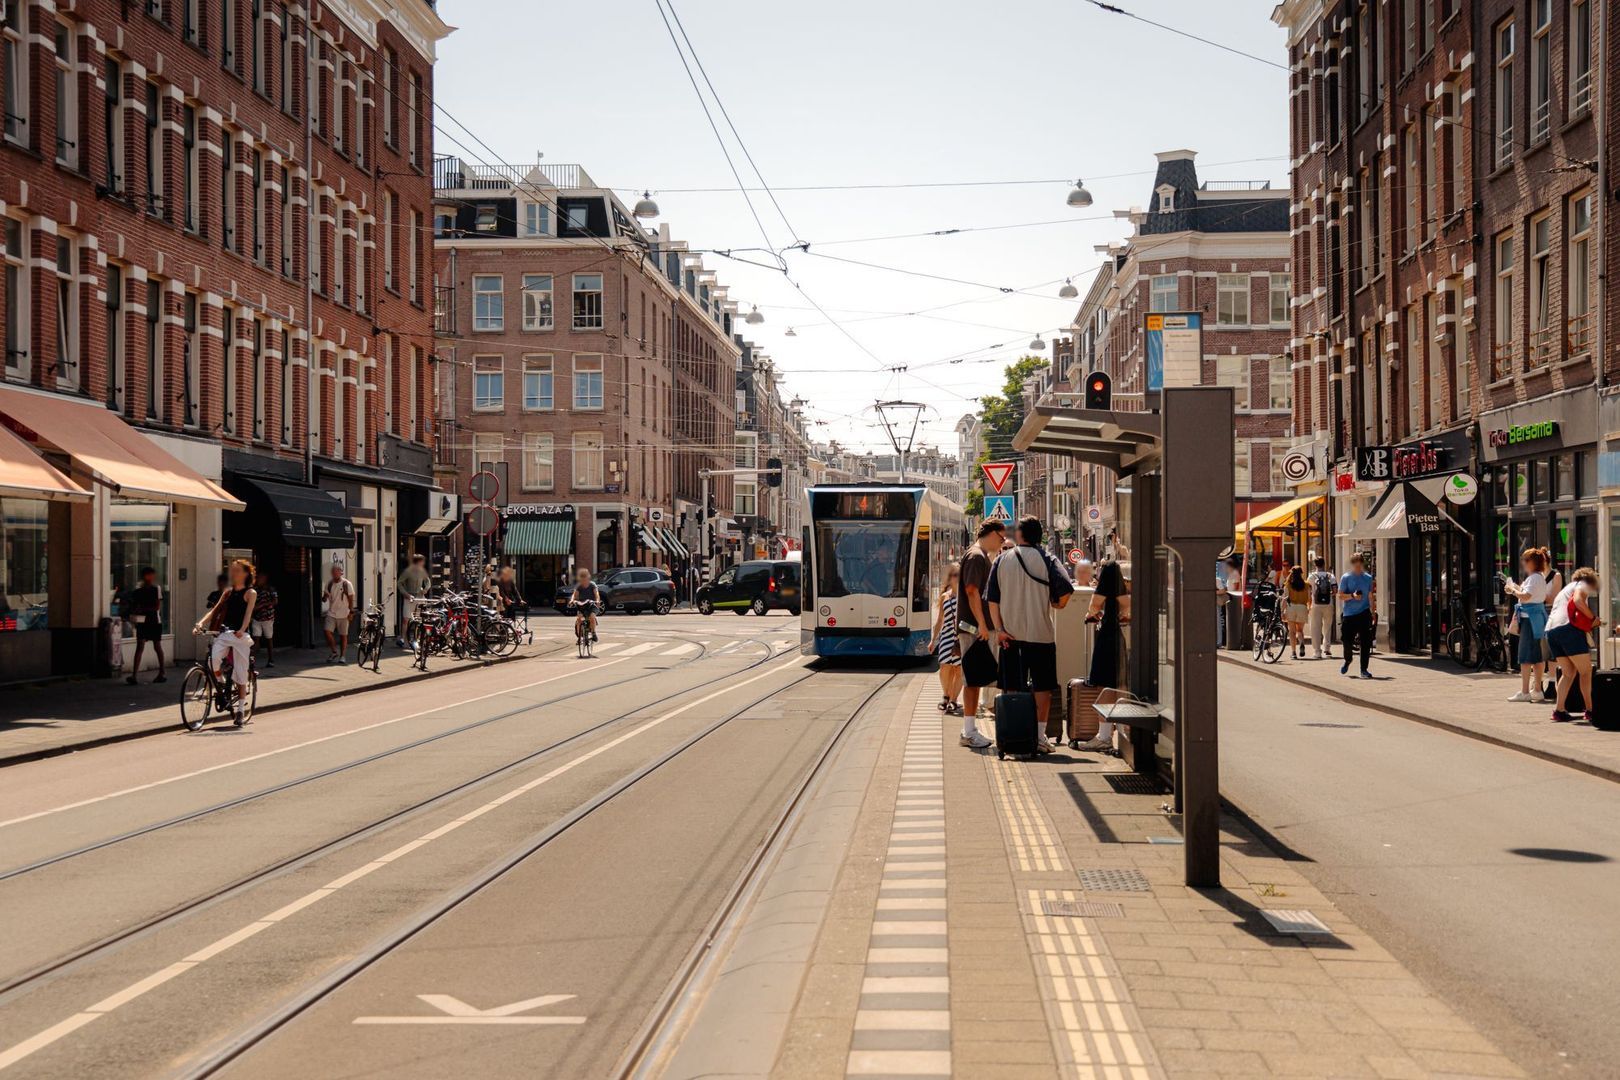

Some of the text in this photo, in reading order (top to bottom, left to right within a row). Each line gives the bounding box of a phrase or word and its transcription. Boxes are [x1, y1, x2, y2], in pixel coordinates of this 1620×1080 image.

[1509, 420, 1553, 444] Bersama
[858, 496, 868, 512] 4
[506, 505, 562, 515] EKOPLAZA
[1407, 513, 1439, 524] Pieter
[1420, 522, 1440, 532] Bas
[1071, 552, 1081, 560] 30
